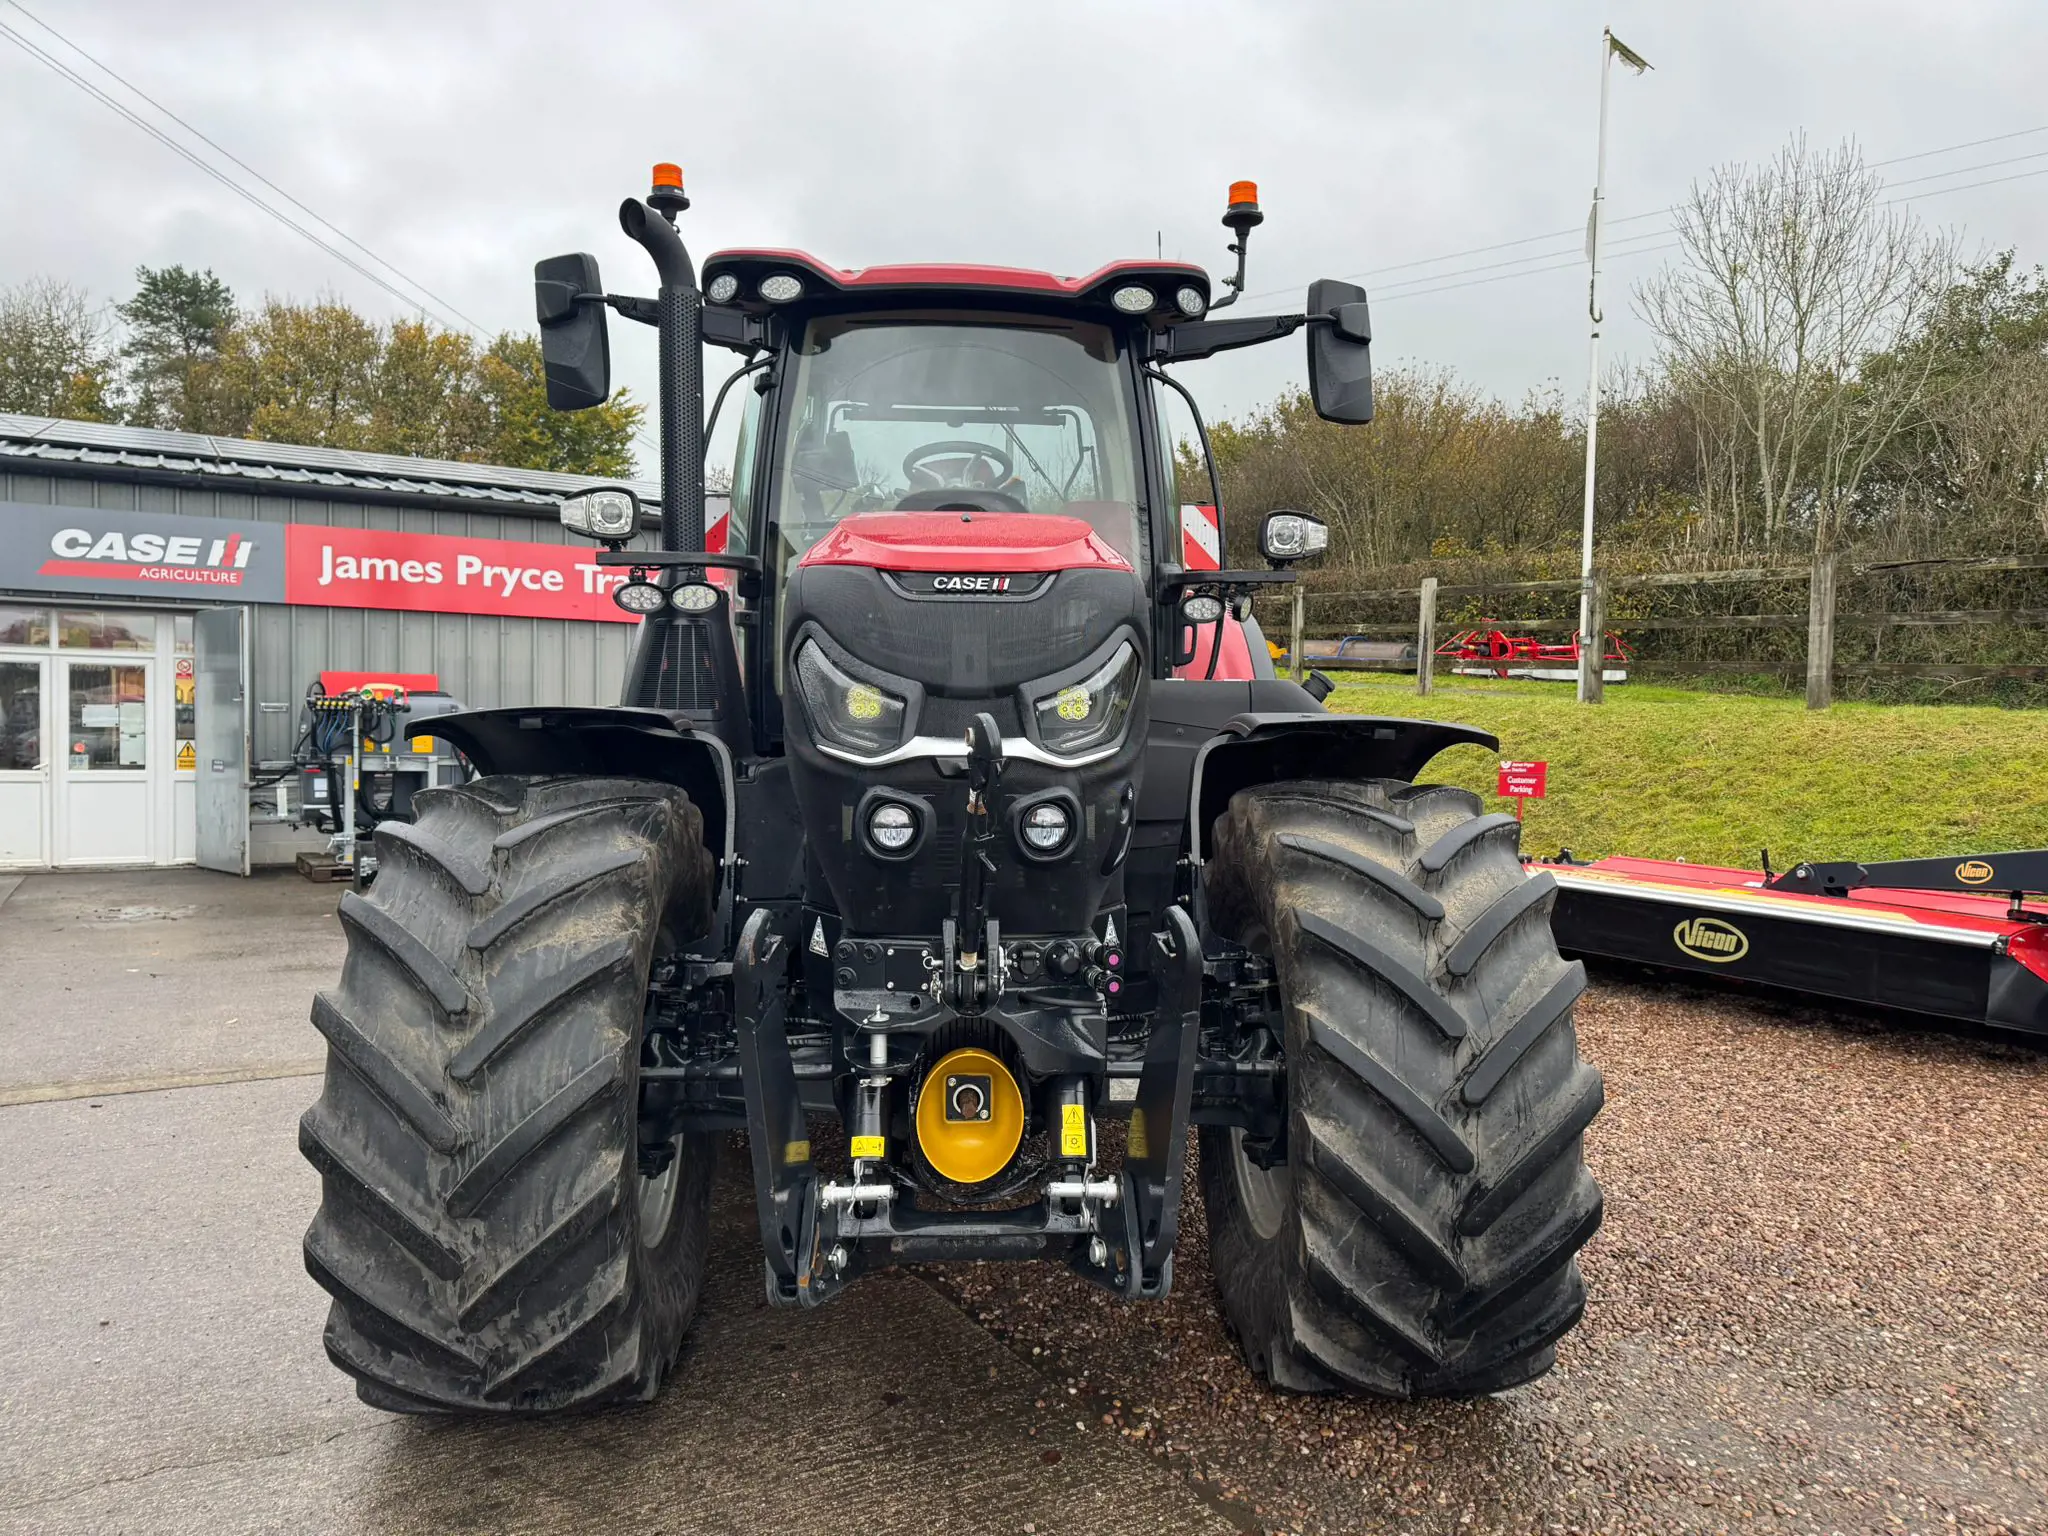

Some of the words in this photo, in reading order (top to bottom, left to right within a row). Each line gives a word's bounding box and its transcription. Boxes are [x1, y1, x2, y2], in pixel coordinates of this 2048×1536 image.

[51, 528, 202, 565] CASE
[139, 567, 238, 584] AGRICULTURE
[317, 545, 443, 586] James
[457, 554, 564, 597] Pryce
[933, 576, 990, 590] CASE
[1507, 775, 1537, 784] Customer
[1509, 785, 1533, 795] Parking
[1683, 918, 1738, 952] Vicon
